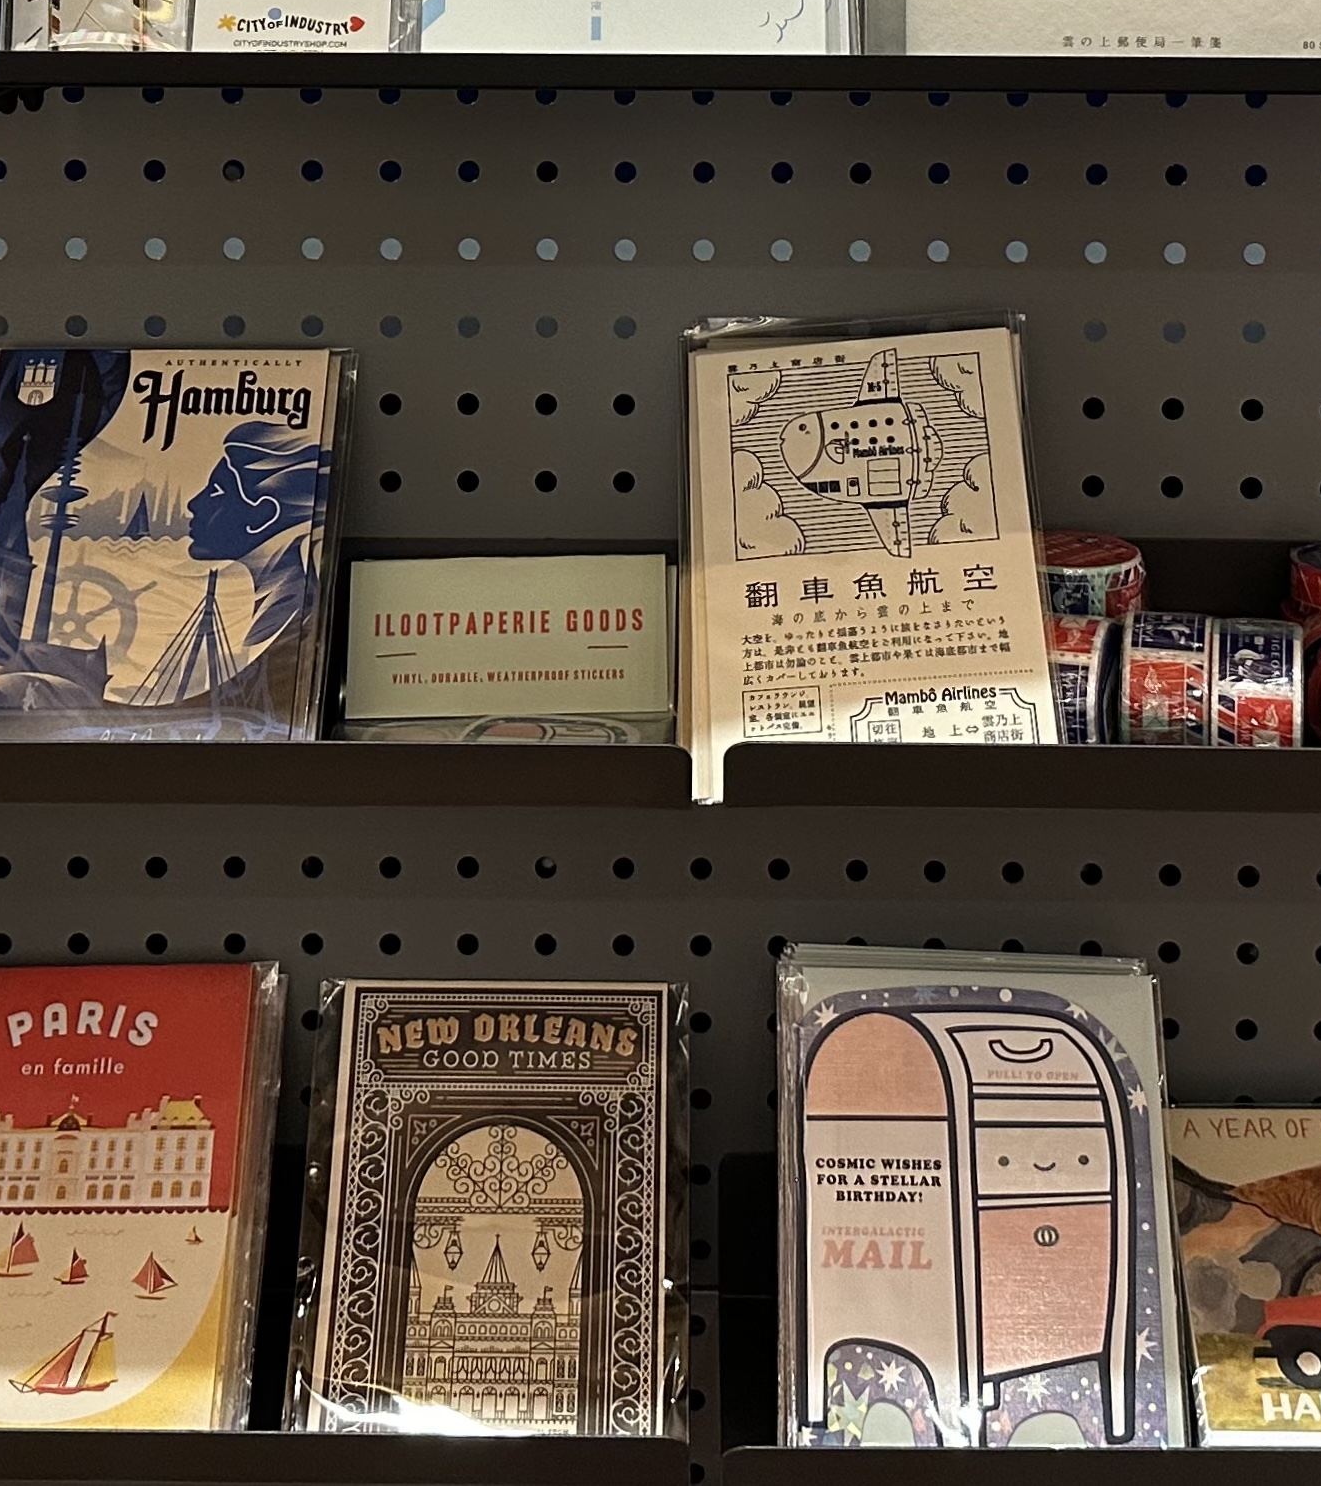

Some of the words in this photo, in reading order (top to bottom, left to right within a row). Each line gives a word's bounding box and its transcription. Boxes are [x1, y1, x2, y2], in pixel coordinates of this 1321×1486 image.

[236, 16, 266, 32] CITY
[283, 14, 350, 35] INDUSTRY
[1302, 41, 1316, 51] 80
[132, 368, 313, 453] Hamburg
[744, 563, 999, 609] 翻車魚航空
[374, 610, 551, 637] ILOOTPAPERIE
[565, 607, 644, 633] GOODS
[885, 686, 938, 705] Mambô
[941, 683, 998, 700] Airlines
[6, 999, 160, 1048] PARIS
[375, 1013, 460, 1055] NEW
[477, 1012, 638, 1057] ORLEANS
[20, 1062, 45, 1077] en
[53, 1057, 125, 1076] famille
[422, 1049, 501, 1070] GOOD
[508, 1049, 593, 1070] TIMES
[1182, 1119, 1200, 1140] A
[1209, 1116, 1278, 1140] YEAR
[1284, 1116, 1316, 1139] OF
[815, 1157, 877, 1171] COSMIC
[881, 1157, 943, 1172] WISHES
[817, 1173, 848, 1187] FOR
[853, 1173, 866, 1187] A
[870, 1173, 941, 1187] STELLAR
[835, 1188, 925, 1204] BIRTHDAY!
[820, 1238, 934, 1271] MAIL
